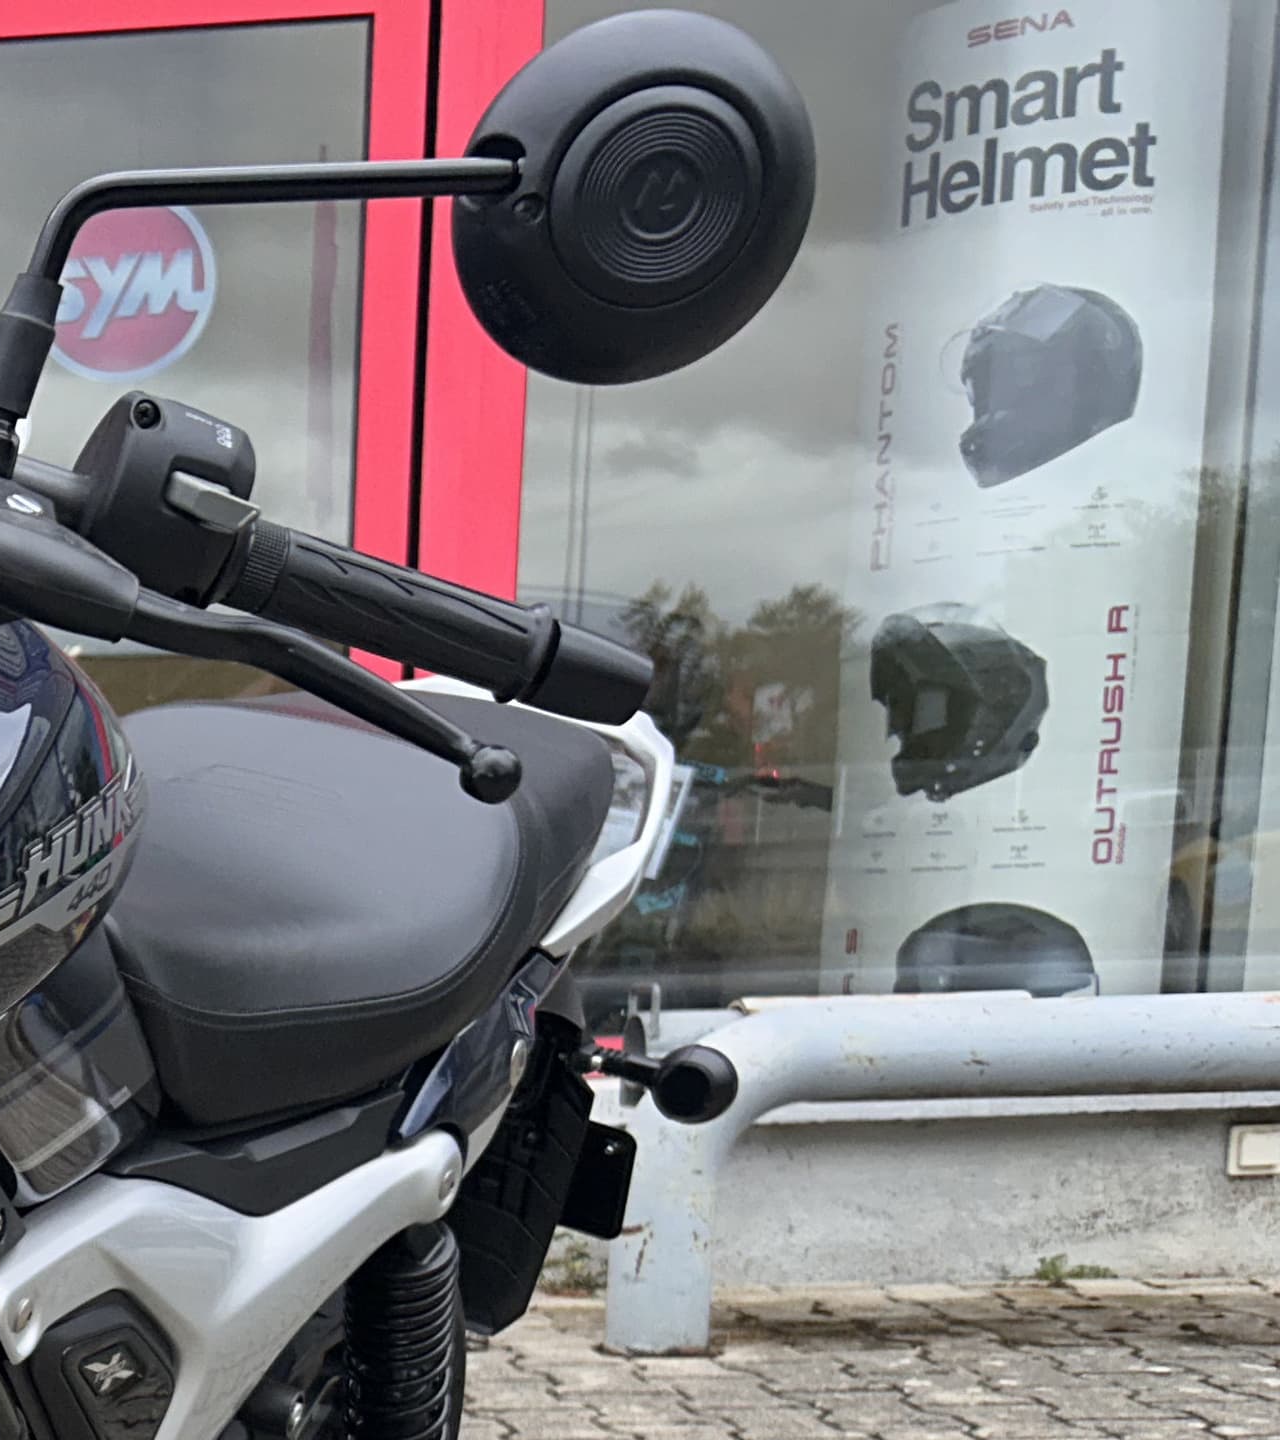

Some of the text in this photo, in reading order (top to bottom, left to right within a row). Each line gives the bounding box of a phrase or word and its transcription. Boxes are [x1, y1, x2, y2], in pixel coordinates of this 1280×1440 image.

[967, 10, 1075, 49] SENA
[905, 48, 1125, 153] Smart
[901, 121, 1158, 229] Helmet
[1068, 198, 1089, 208] and
[56, 249, 208, 340] SYM
[870, 322, 899, 572] PHANTOM
[1092, 652, 1127, 865] OUTRUSH
